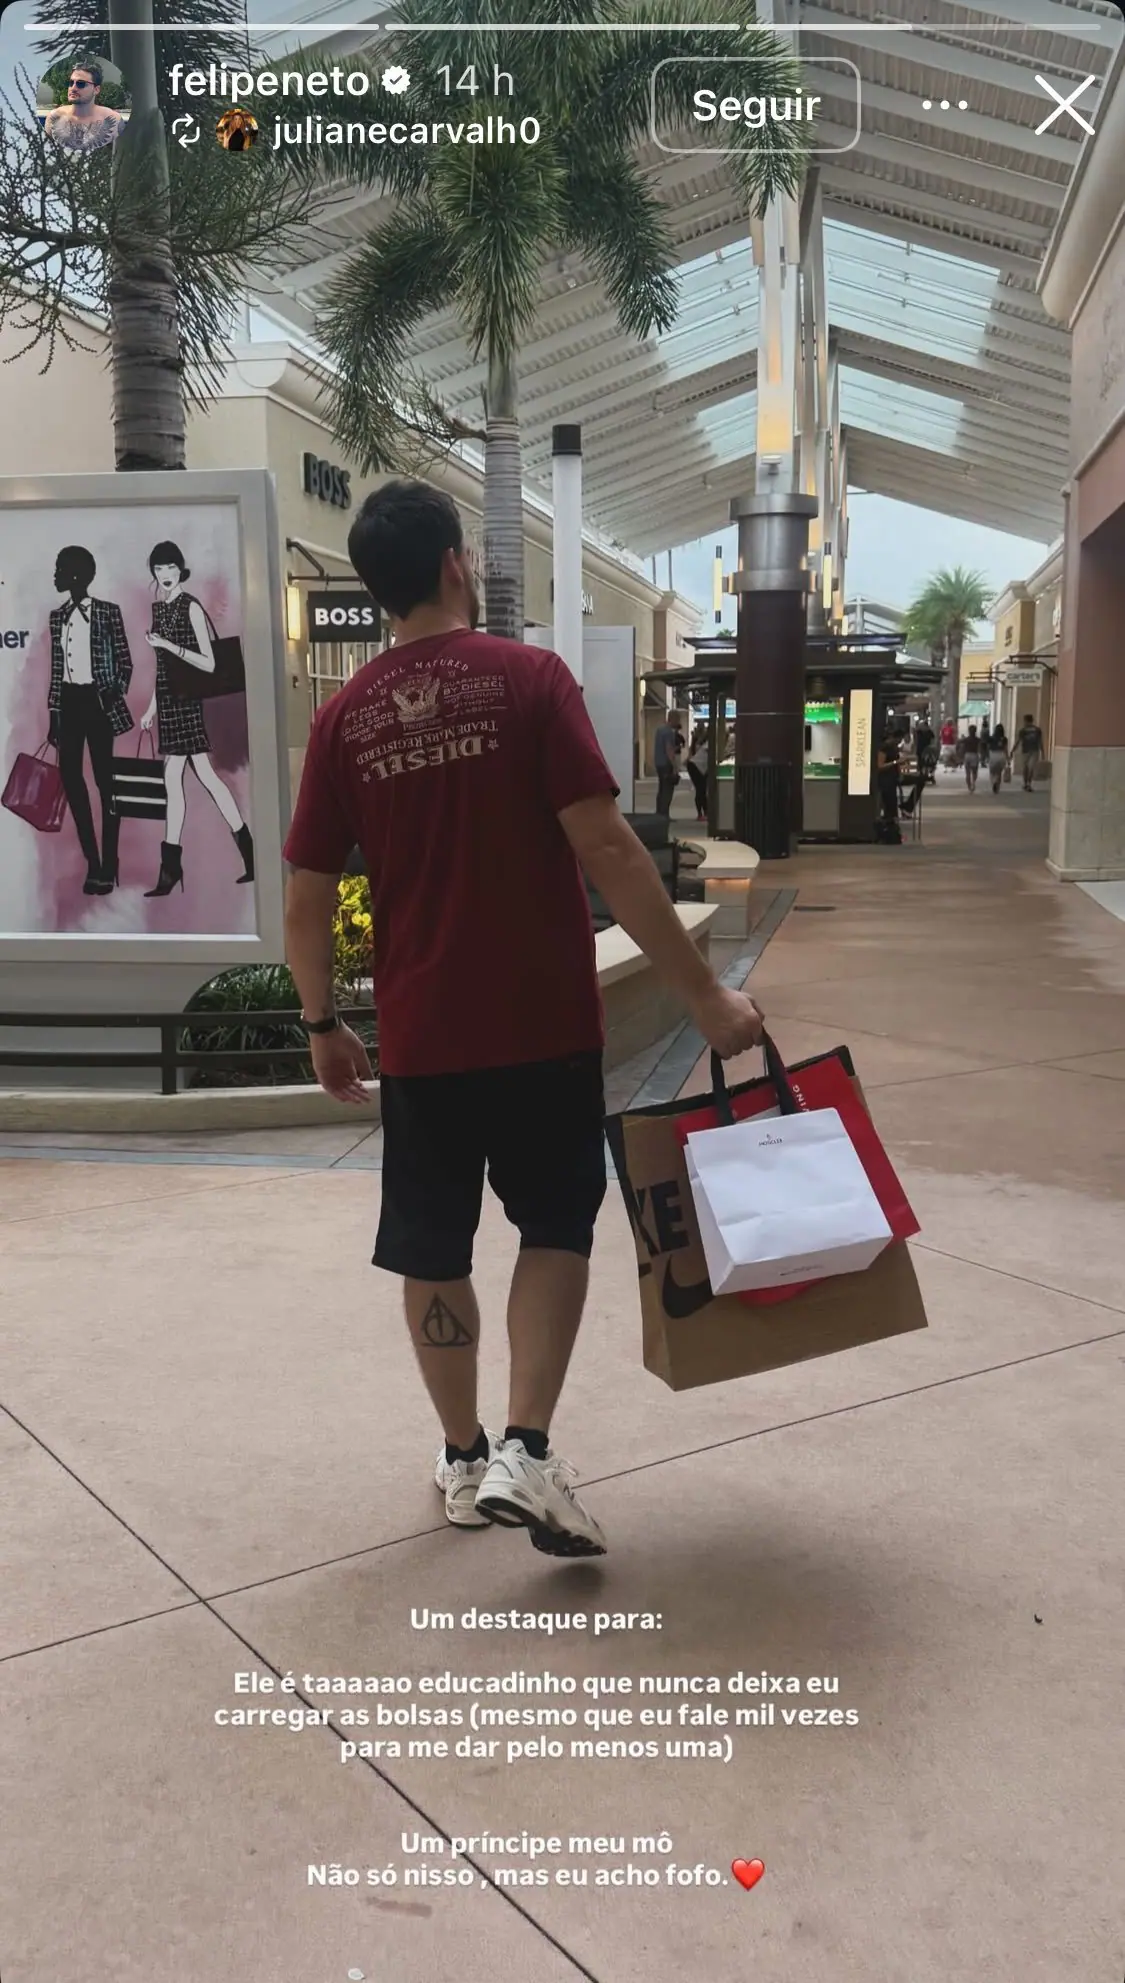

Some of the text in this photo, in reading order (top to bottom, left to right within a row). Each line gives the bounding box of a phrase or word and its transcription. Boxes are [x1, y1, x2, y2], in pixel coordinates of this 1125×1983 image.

[304, 452, 352, 509] BOSS
[315, 607, 374, 626] BOSS
[0, 630, 29, 649] er
[366, 667, 406, 696] DIESEL
[443, 680, 504, 696] BY DIESEL
[367, 711, 394, 725] GOOD
[457, 720, 499, 734] TRADE
[356, 735, 423, 765] REGISTERED
[370, 735, 484, 780] DIESEL
